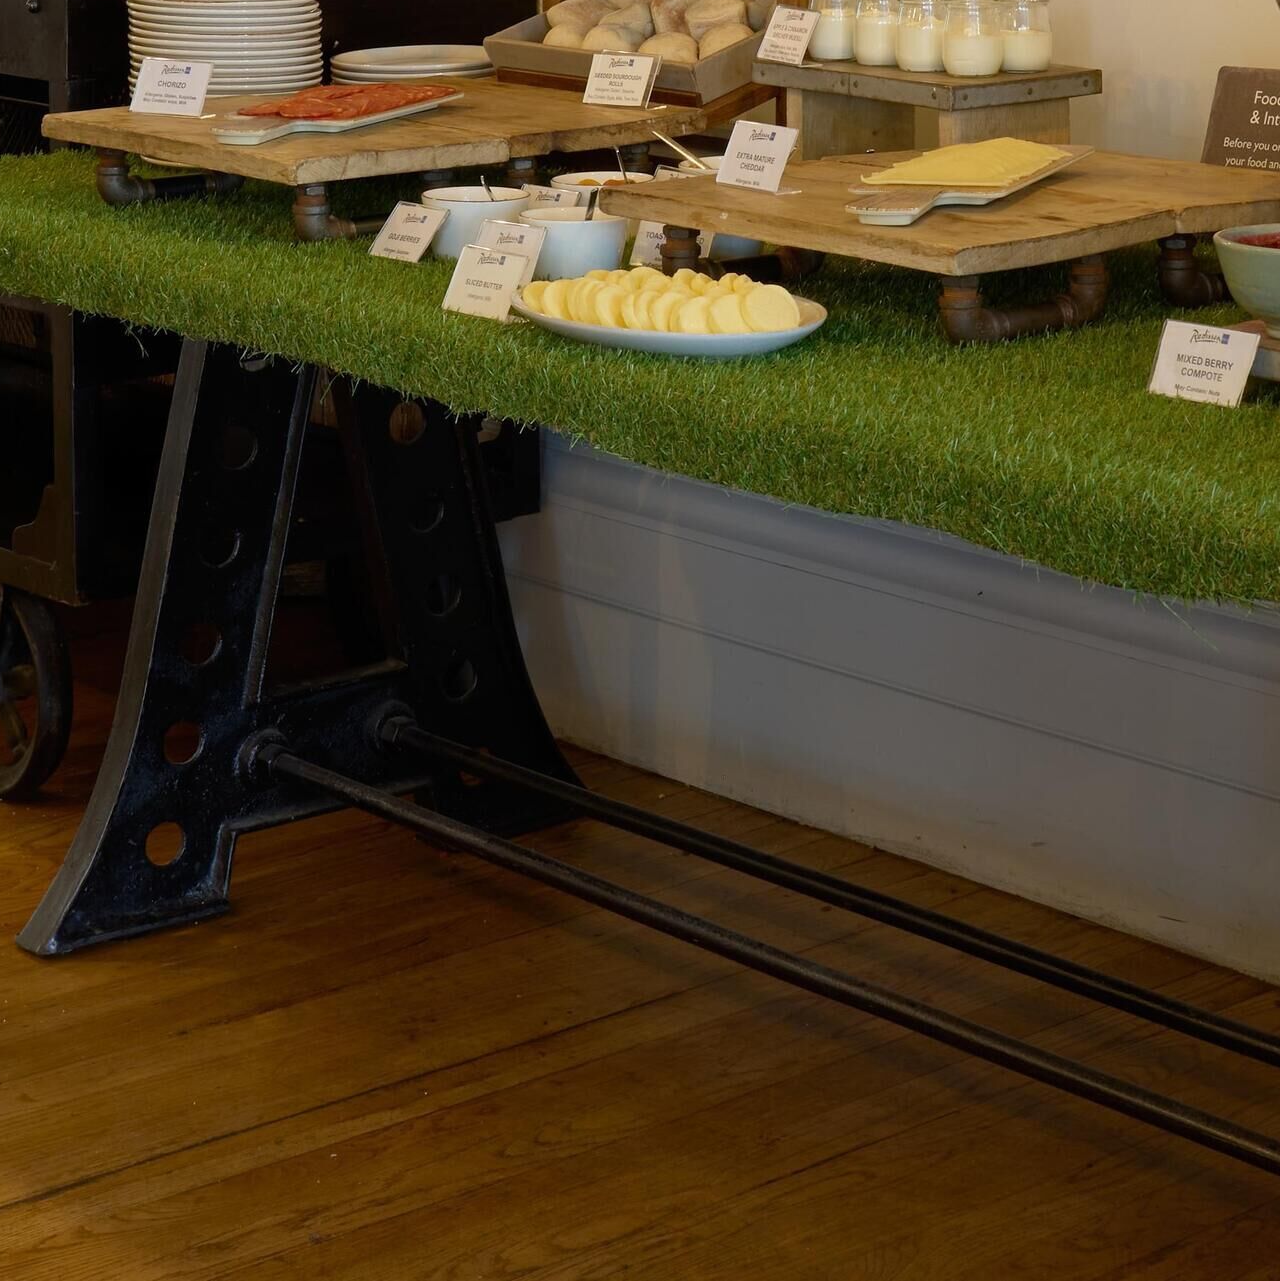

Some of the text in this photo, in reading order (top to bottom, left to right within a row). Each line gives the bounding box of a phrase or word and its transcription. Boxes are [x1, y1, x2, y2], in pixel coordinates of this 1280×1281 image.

[157, 80, 187, 89] CHORIZO
[1250, 109, 1260, 125] &
[1223, 136, 1252, 150] Before
[1253, 140, 1271, 153] you
[736, 151, 776, 165] EXTRA MATURE
[1224, 156, 1246, 168] your
[1247, 156, 1268, 169] food
[740, 161, 765, 173] CHEDDAR
[400, 233, 422, 245] BERRIES
[646, 231, 666, 241] TOAS
[465, 278, 504, 291] SLICED BUTTER
[1177, 353, 1234, 371] MIXED BERRY
[1181, 366, 1224, 383] COMPOTE
